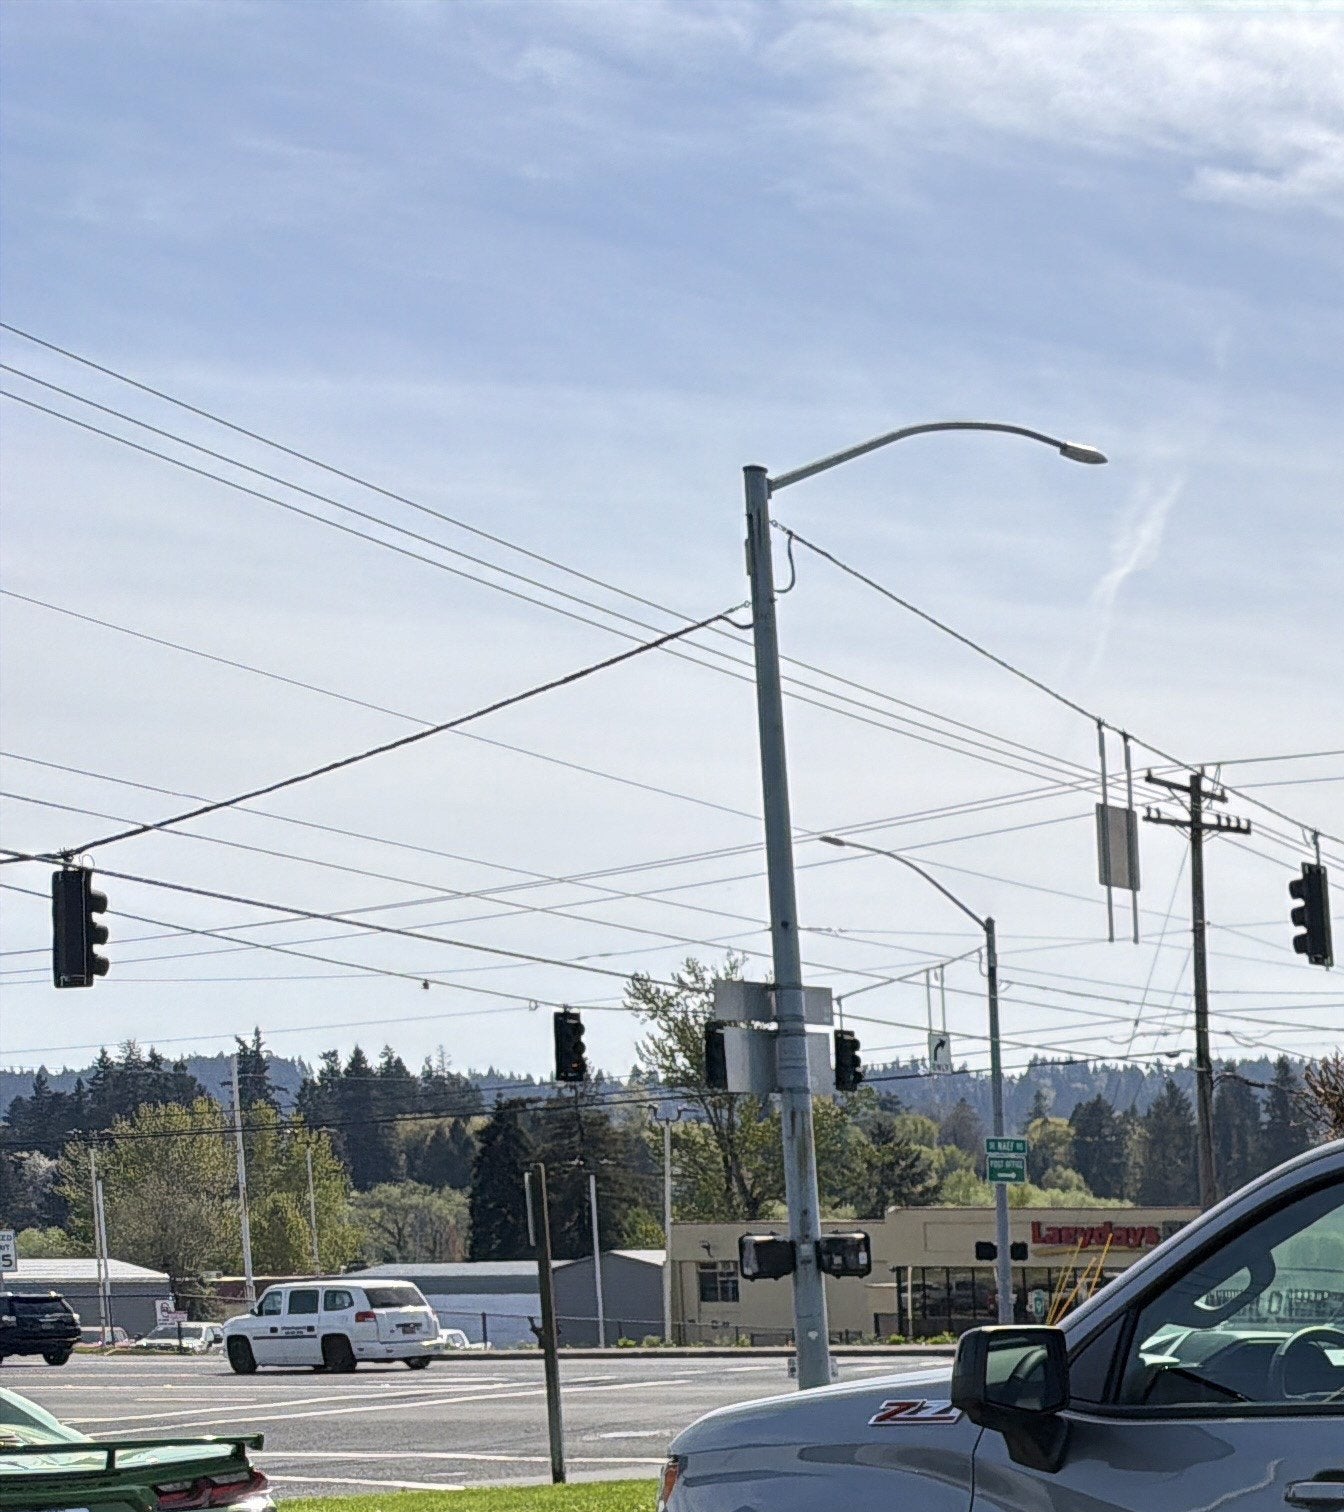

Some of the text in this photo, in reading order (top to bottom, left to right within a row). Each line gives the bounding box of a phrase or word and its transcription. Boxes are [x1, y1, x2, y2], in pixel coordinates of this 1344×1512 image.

[1031, 1221, 1161, 1249] Lazydays
[1, 1254, 13, 1268] 5
[868, 1399, 962, 1425] Z7
